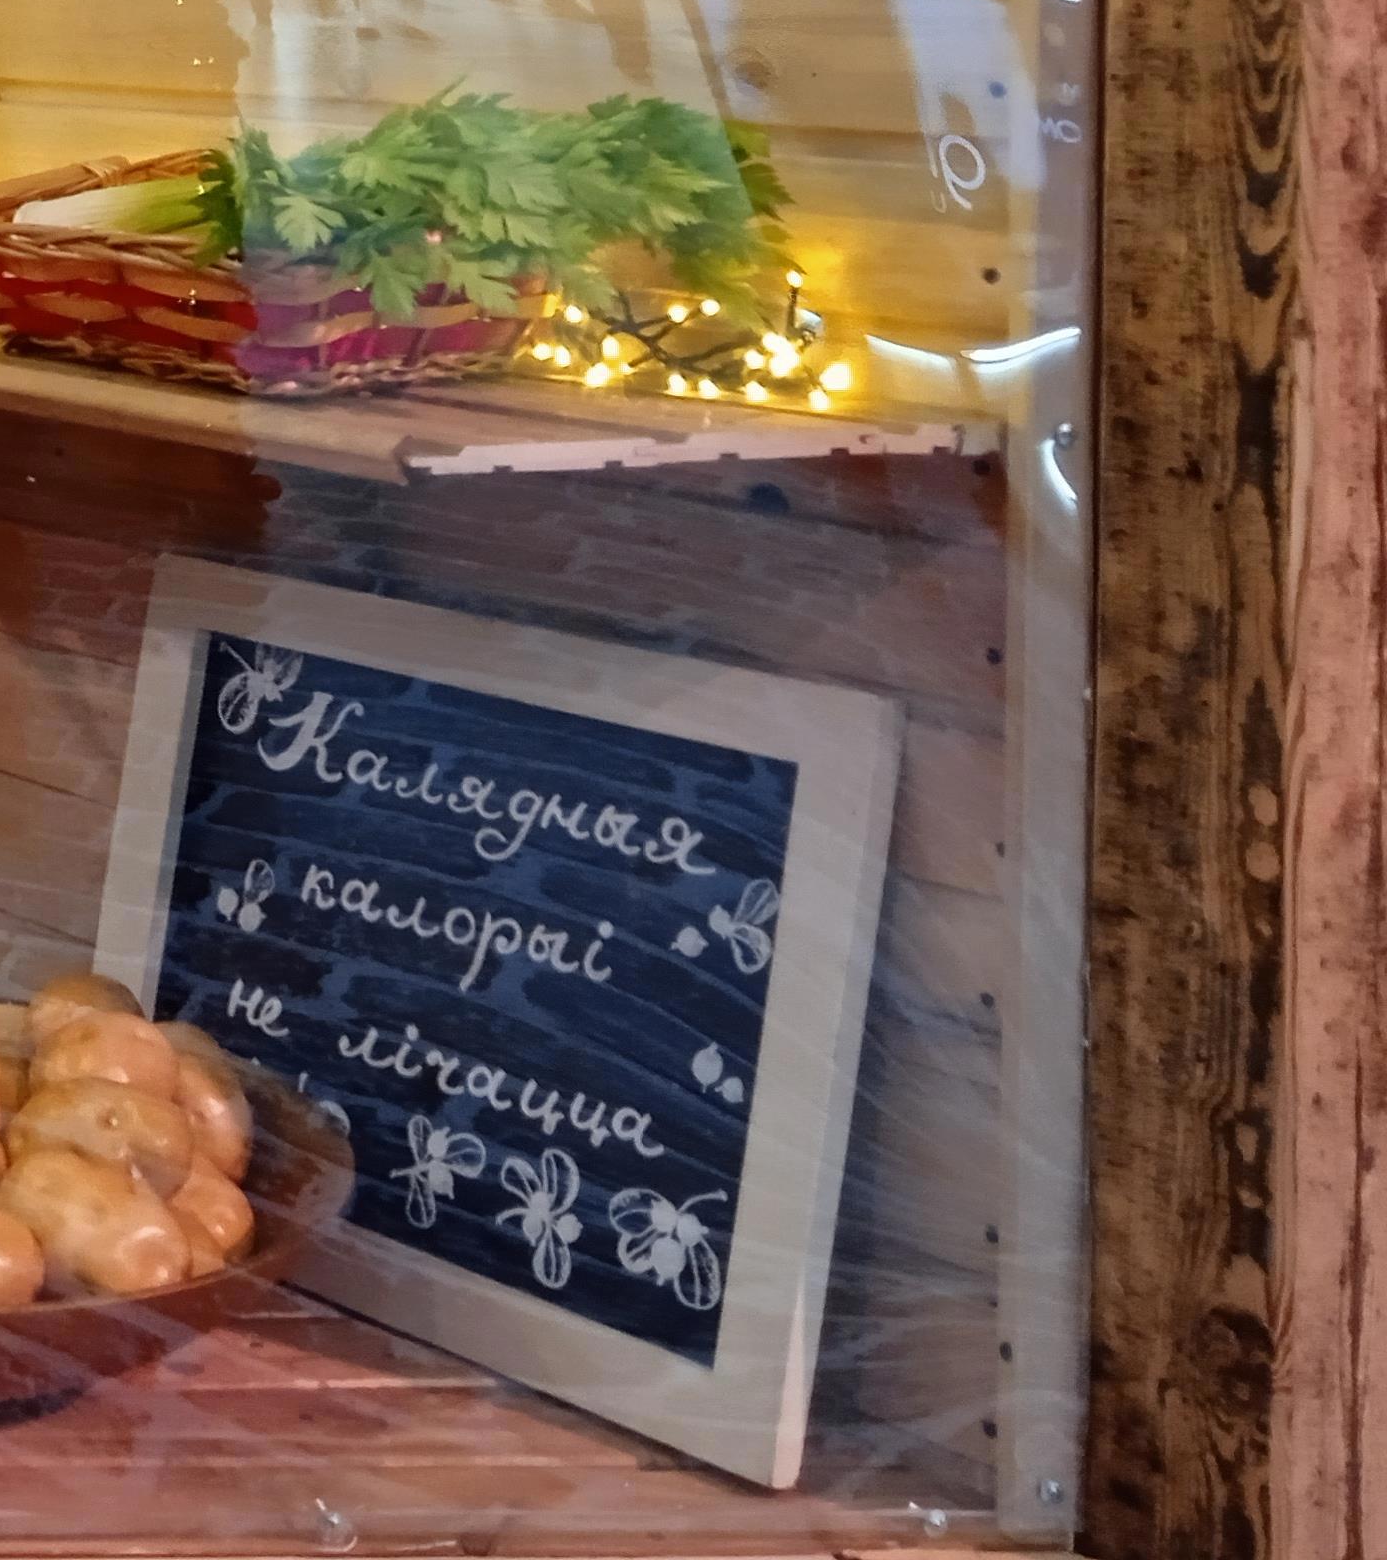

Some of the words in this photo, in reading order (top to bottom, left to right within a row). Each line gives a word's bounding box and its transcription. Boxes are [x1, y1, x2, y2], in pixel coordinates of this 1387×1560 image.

[256, 691, 717, 878] Калядныя
[300, 861, 613, 994] калорыі
[227, 977, 290, 1038] не
[338, 1024, 665, 1159] лічацца
